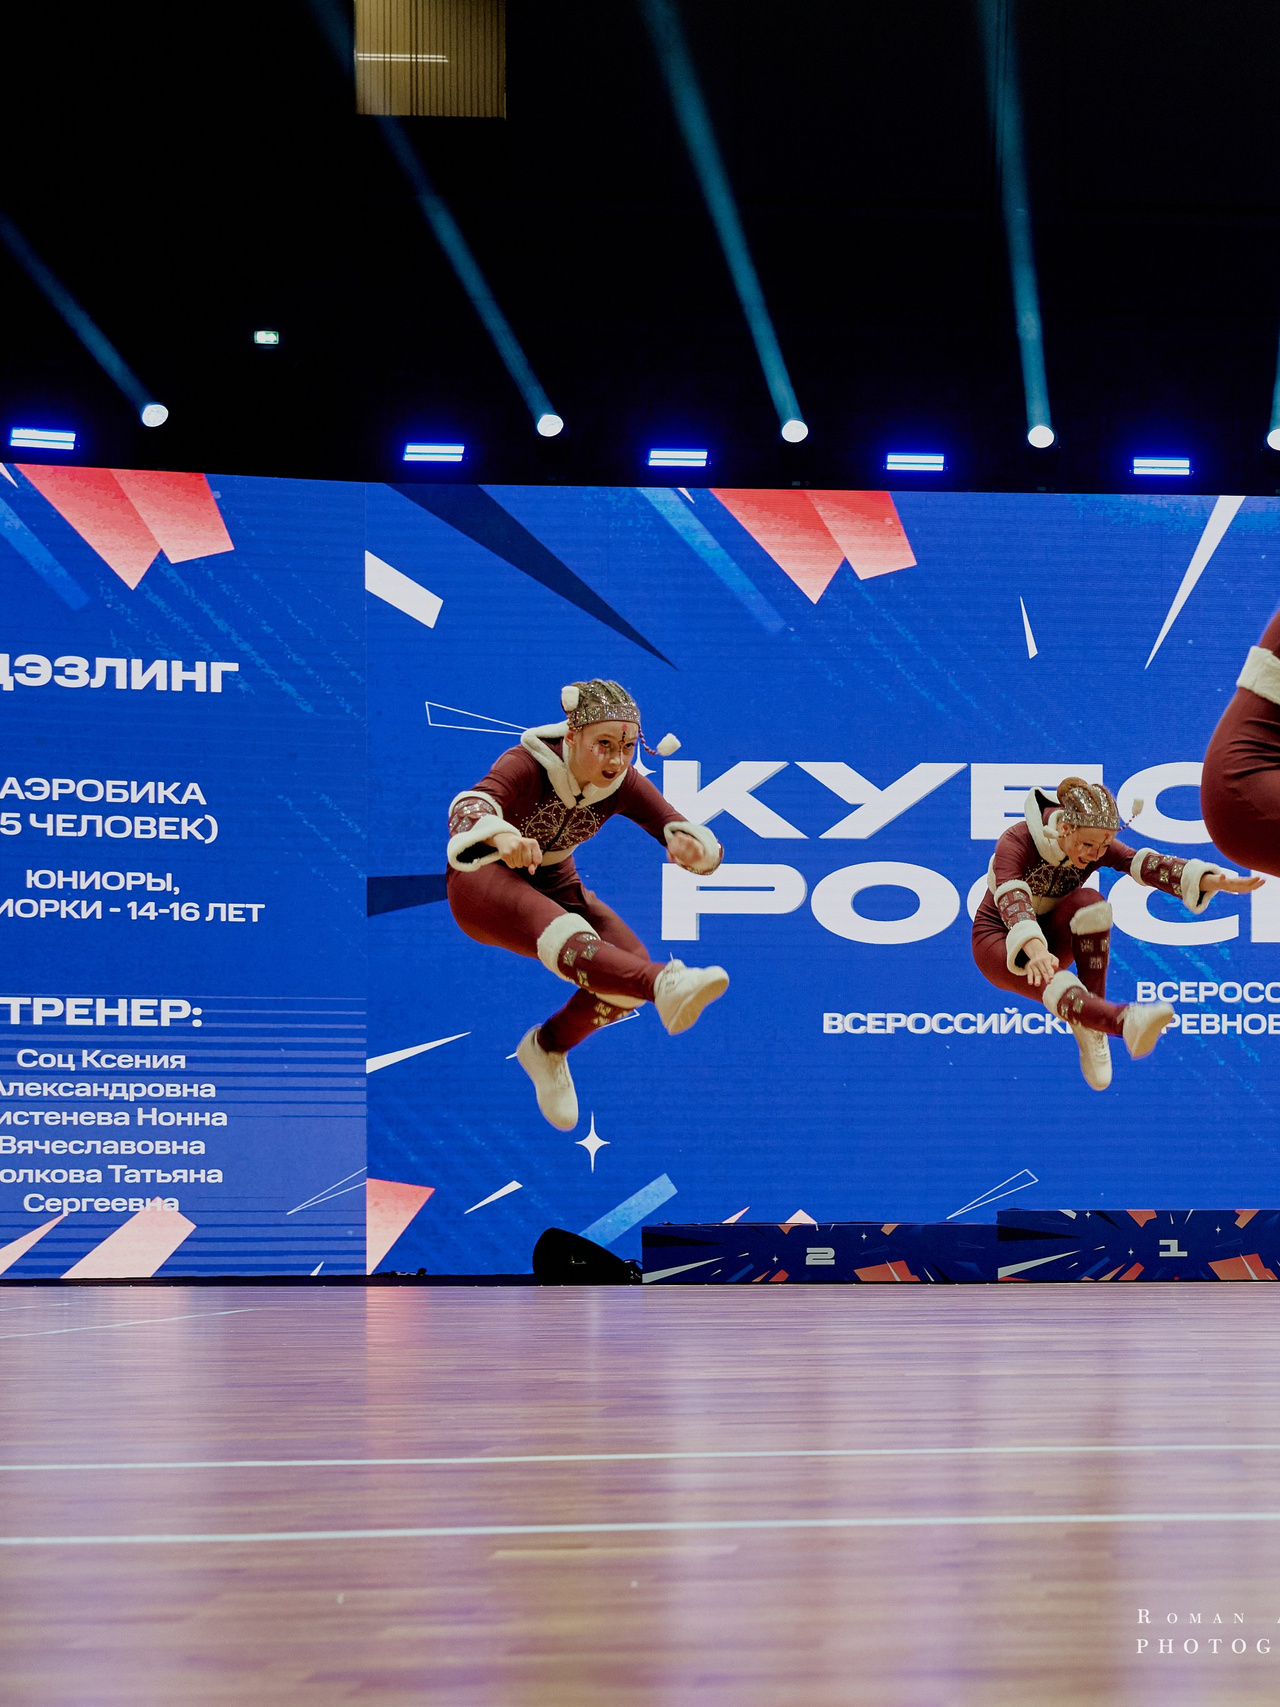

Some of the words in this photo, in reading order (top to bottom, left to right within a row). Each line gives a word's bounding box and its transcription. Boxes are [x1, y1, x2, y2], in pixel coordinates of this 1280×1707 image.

[0, 776, 207, 805] АЭРОБИКА
[662, 760, 1212, 843] КУБО
[29, 813, 219, 845] ЧЕЛОВЕК)
[26, 869, 180, 896] ЮНИОРЫ,
[127, 901, 200, 922] 14-16
[205, 903, 266, 923] ЛЕТ
[0, 997, 203, 1028] ТРЕНЕР:
[822, 1007, 1074, 1035] ВСЕРОССИЙСК
[16, 1049, 76, 1072] Соц
[82, 1049, 186, 1069] Ксения
[137, 1107, 228, 1126] Нонна
[0, 1135, 206, 1155] Вячеславовна
[0, 1168, 103, 1183] олкова
[107, 1164, 224, 1183] Татьяна
[23, 1193, 180, 1216] Сергеевна
[805, 1247, 836, 1266] 2
[1158, 1239, 1189, 1258] 1
